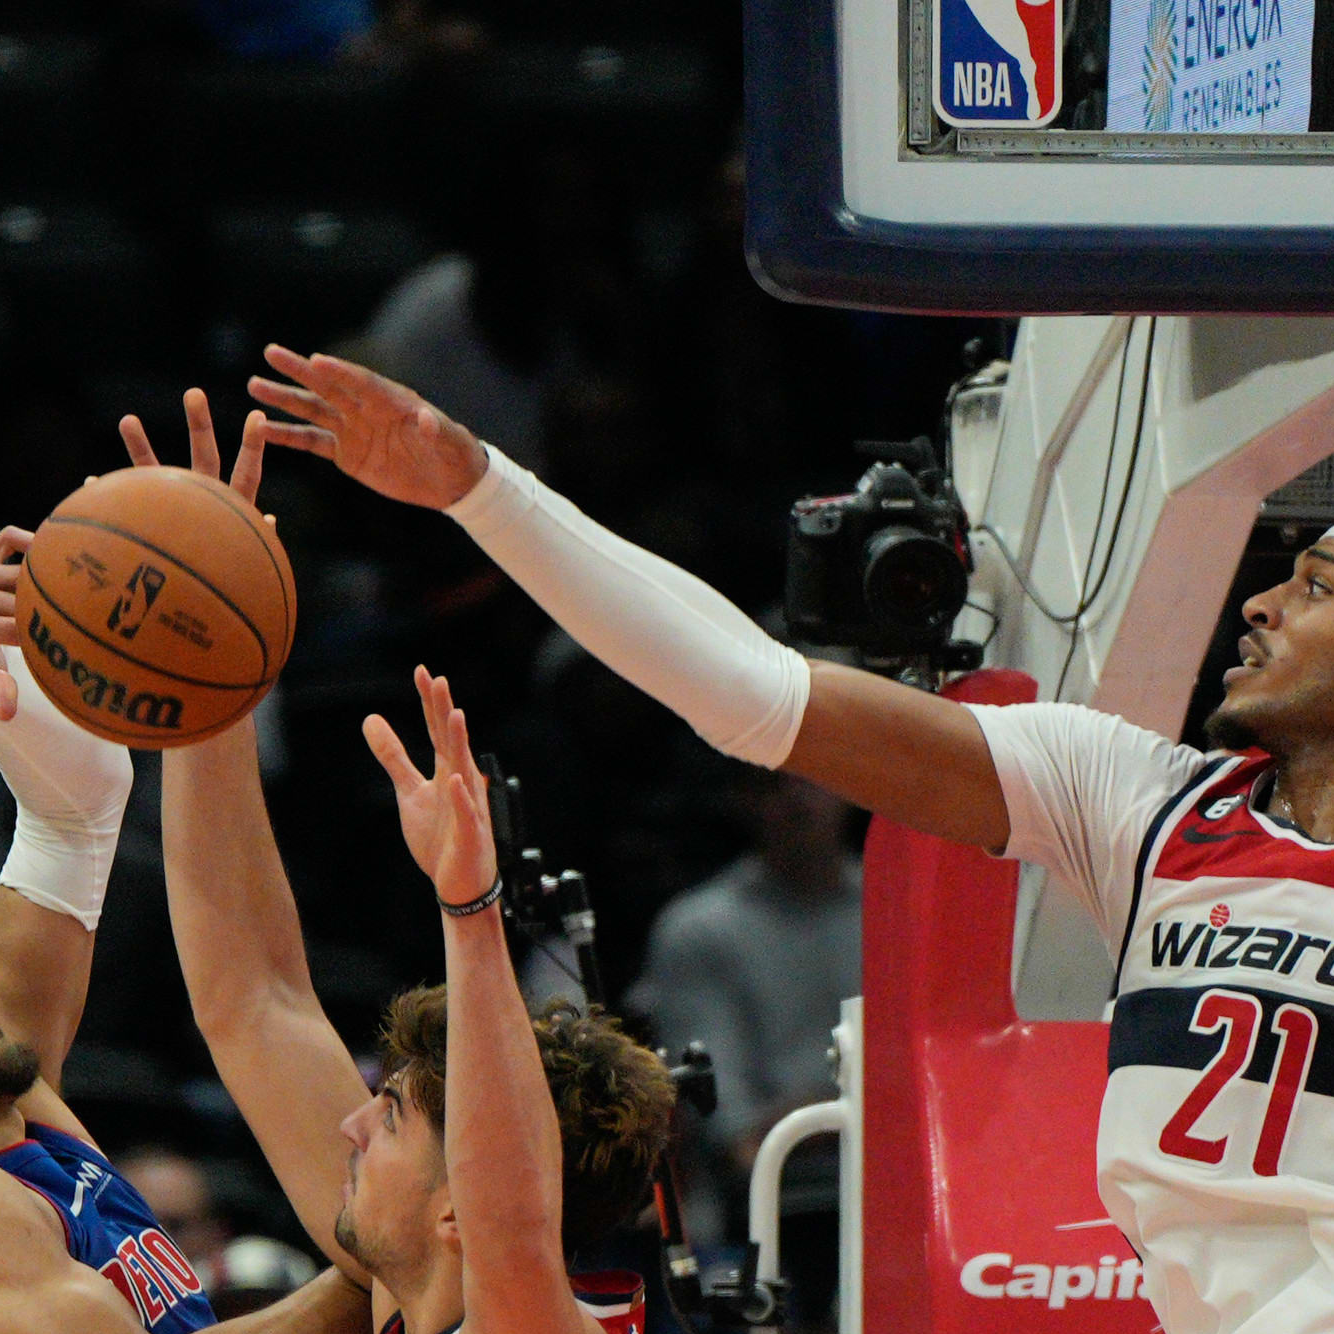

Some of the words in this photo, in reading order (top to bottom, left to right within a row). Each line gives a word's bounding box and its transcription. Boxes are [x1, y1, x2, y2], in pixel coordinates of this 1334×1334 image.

[953, 61, 1012, 108] NBA
[1182, 59, 1281, 132] RENEWABLES
[28, 607, 183, 728] Wilson
[1158, 990, 1319, 1177] 21
[960, 1253, 1150, 1309] Capit
